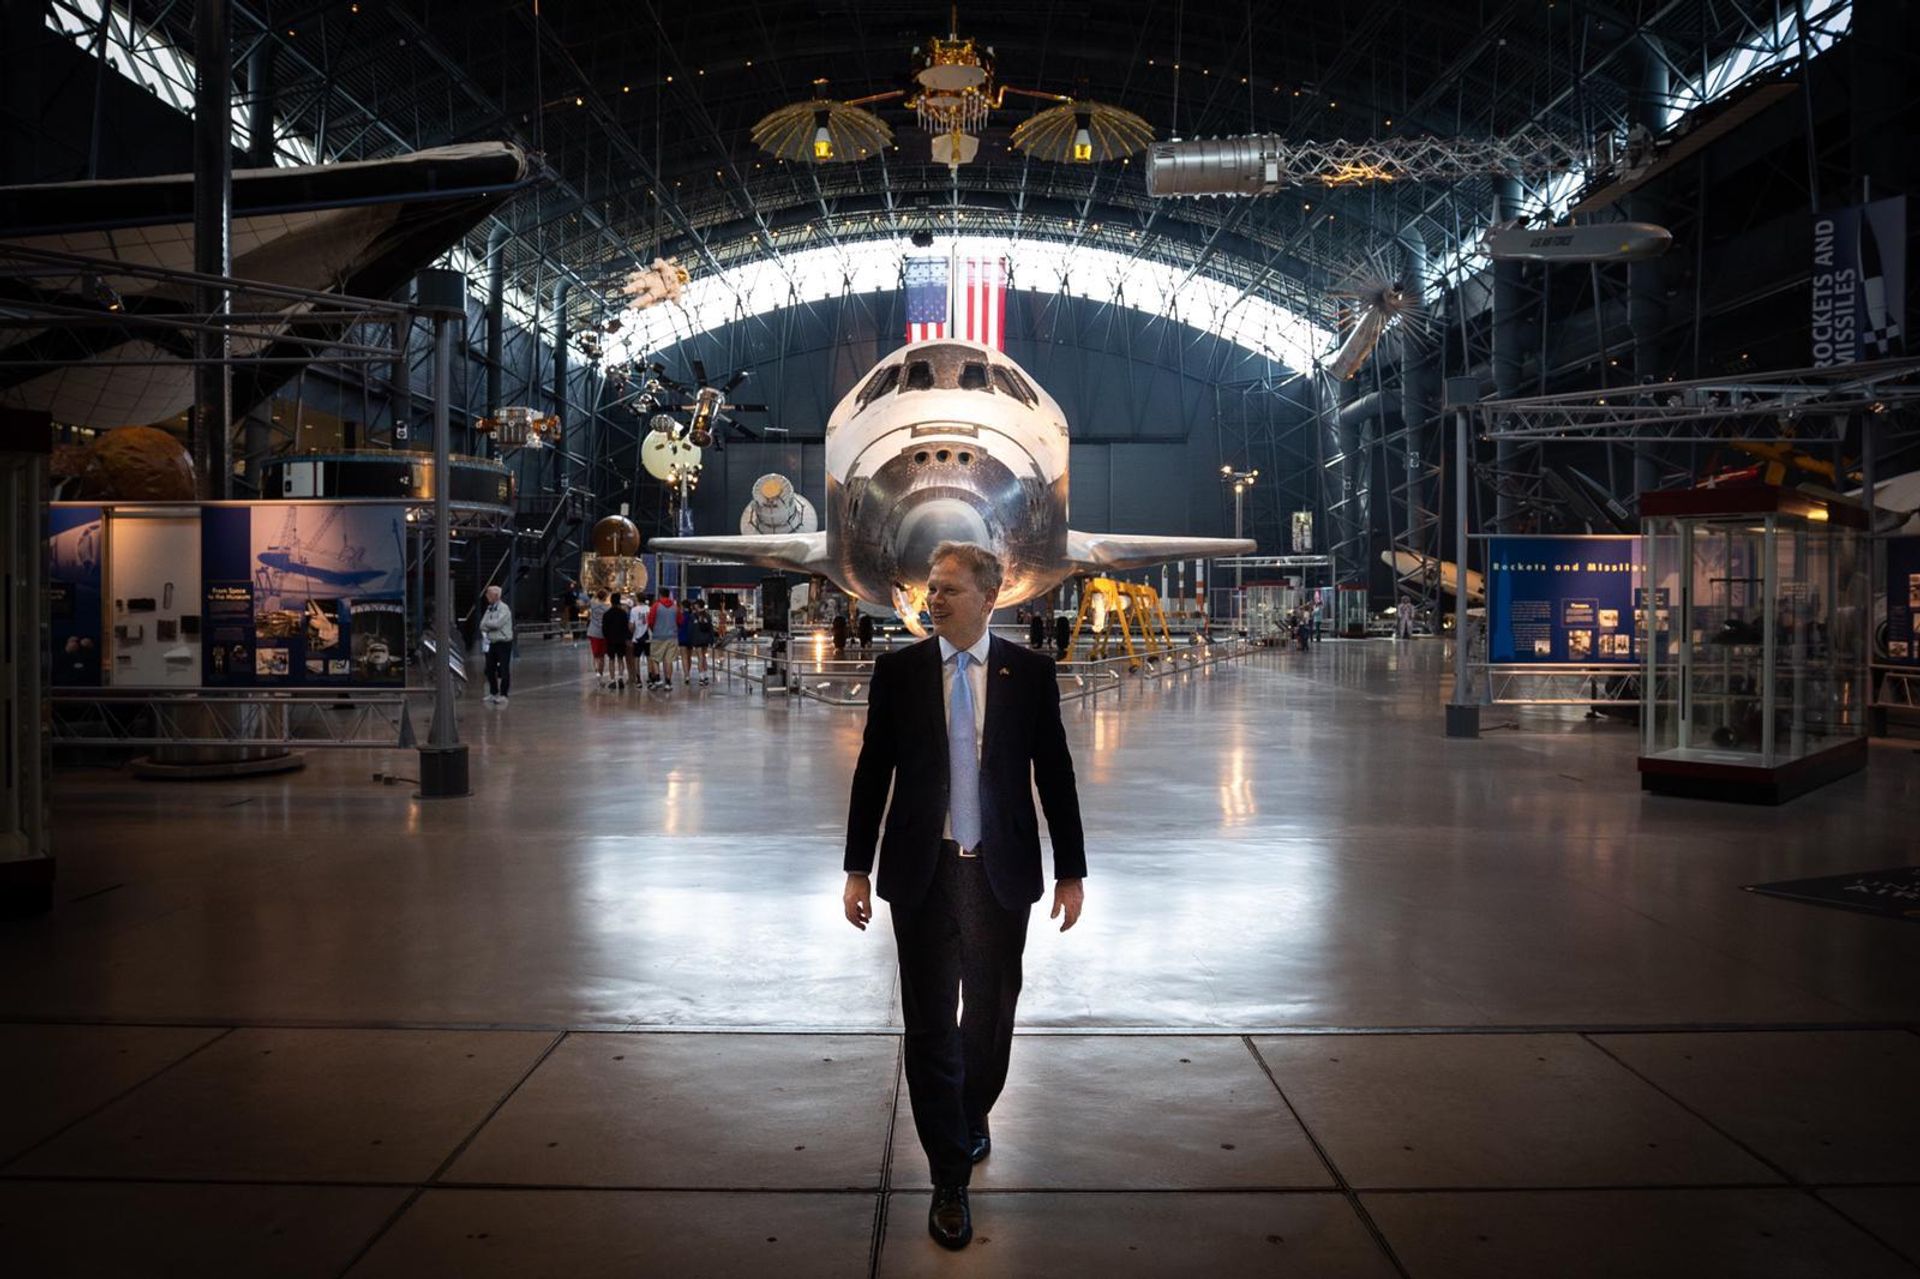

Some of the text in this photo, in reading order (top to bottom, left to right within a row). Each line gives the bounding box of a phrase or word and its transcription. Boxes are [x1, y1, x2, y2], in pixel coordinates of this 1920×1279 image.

[1814, 219, 1834, 266] AND
[1492, 562, 1547, 572] Rockets
[1554, 562, 1580, 572] and
